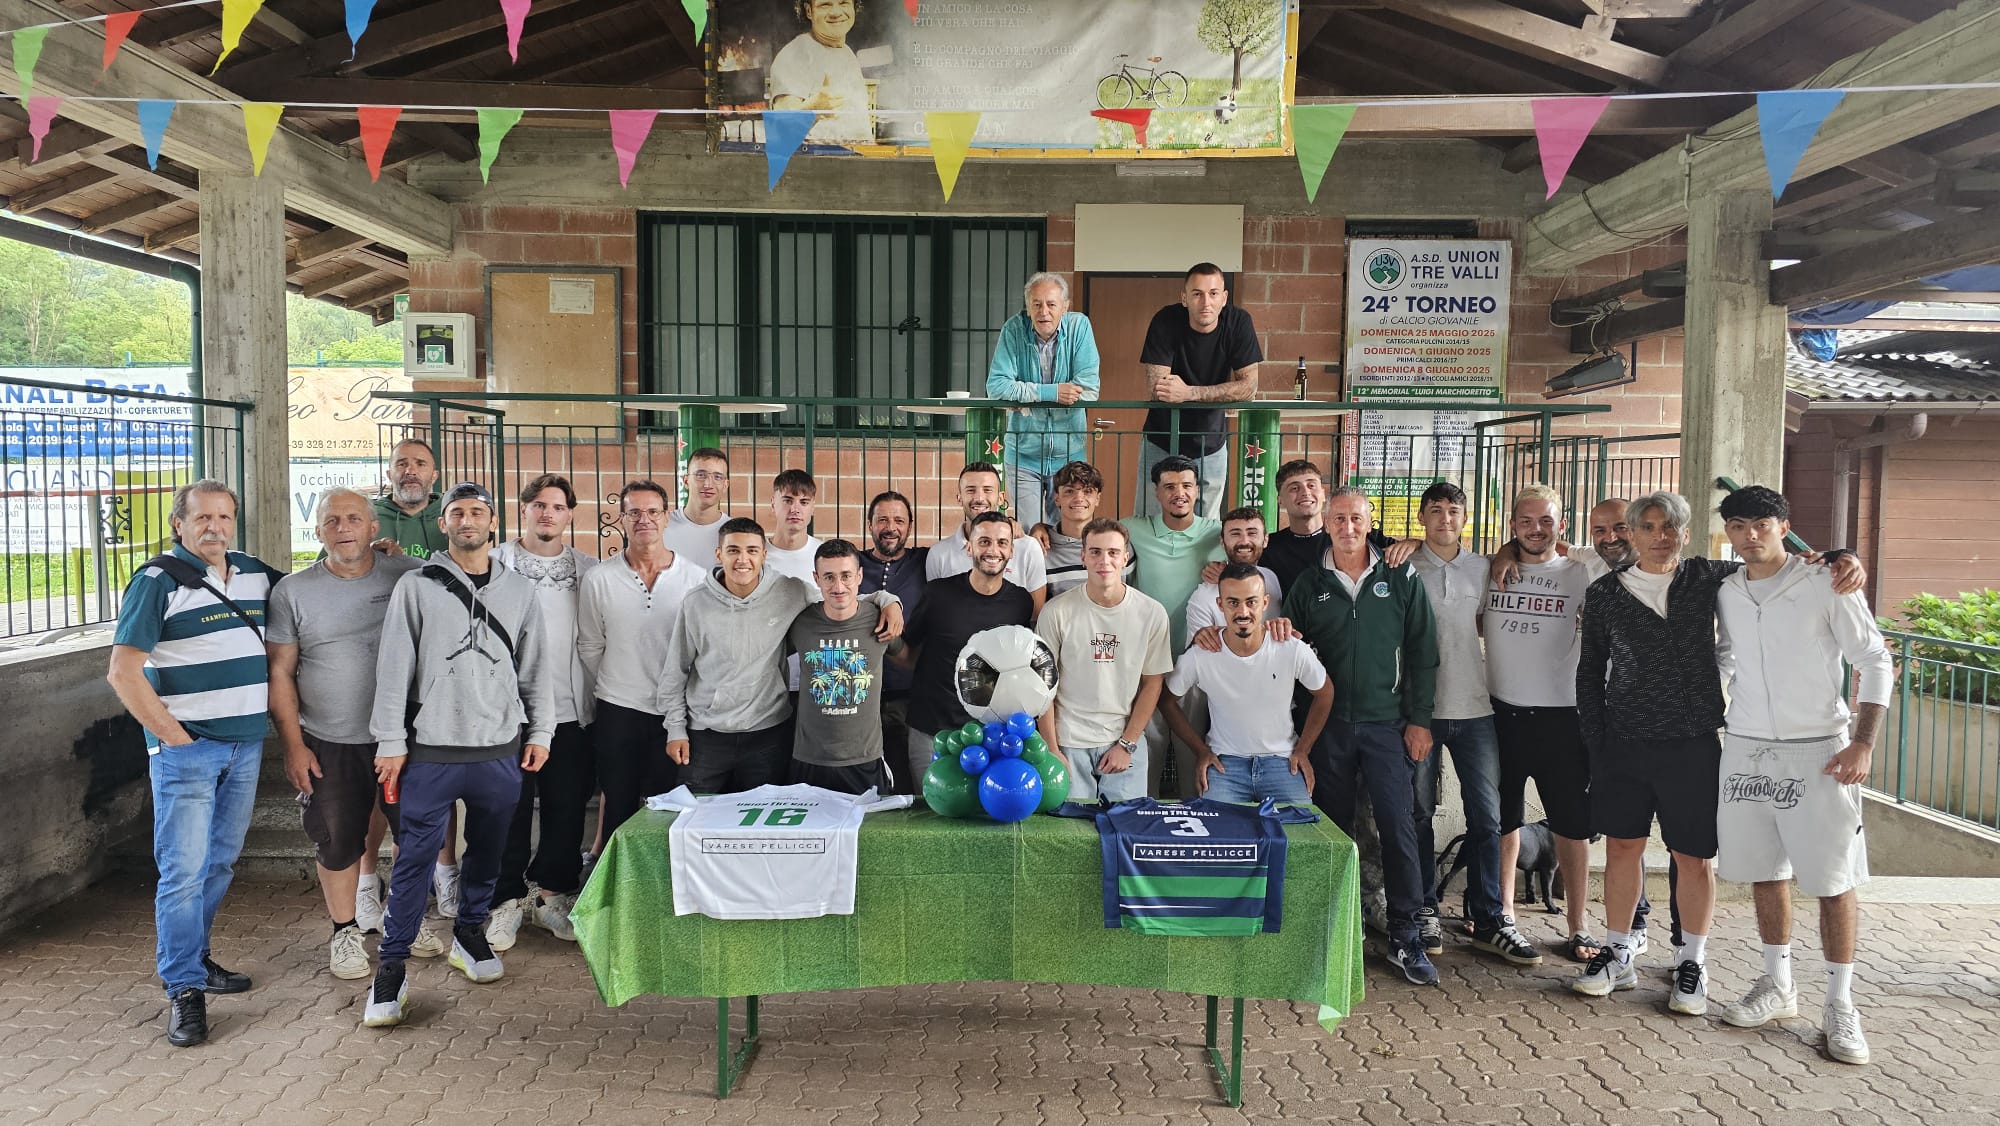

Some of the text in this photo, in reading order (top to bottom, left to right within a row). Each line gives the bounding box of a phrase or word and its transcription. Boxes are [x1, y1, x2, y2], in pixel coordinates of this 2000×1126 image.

[935, 4, 971, 13] AMICO
[1004, 4, 1033, 13] COSA
[937, 18, 968, 27] VERA
[972, 18, 993, 27] CHE
[925, 45, 935, 54] IL
[940, 45, 1001, 55] COMPAGNO
[1032, 46, 1080, 56] VIAGGIO
[937, 58, 985, 68] GRANDE
[988, 58, 1011, 68] CHE
[1015, 59, 1033, 68] FAI
[1411, 254, 1442, 263] A.S.D.
[1448, 251, 1499, 263] UNION
[1411, 266, 1499, 279] TRE VALLI
[1410, 282, 1449, 290] organizza
[1362, 296, 1496, 313] 24° TORNEO
[1379, 315, 1479, 325] di CALCIO GIOVANILE
[1361, 329, 1413, 337] DOMENICA
[1426, 366, 1464, 374] GIUGNO
[0, 384, 74, 404] NALI
[128, 407, 181, 415] COPERTURE
[33, 422, 54, 432] Va
[306, 440, 324, 449] 328
[326, 440, 374, 449] 21.37.725
[300, 472, 354, 486] Occhiali
[1243, 466, 1264, 508] Hei
[1491, 594, 1565, 613] HILFIGER
[1501, 619, 1540, 634] 1985
[820, 639, 859, 648] BEACH
[448, 667, 496, 678] AIR
[738, 808, 809, 827] 16
[1163, 816, 1210, 837] 3
[1193, 849, 1252, 857] PELLICCE
